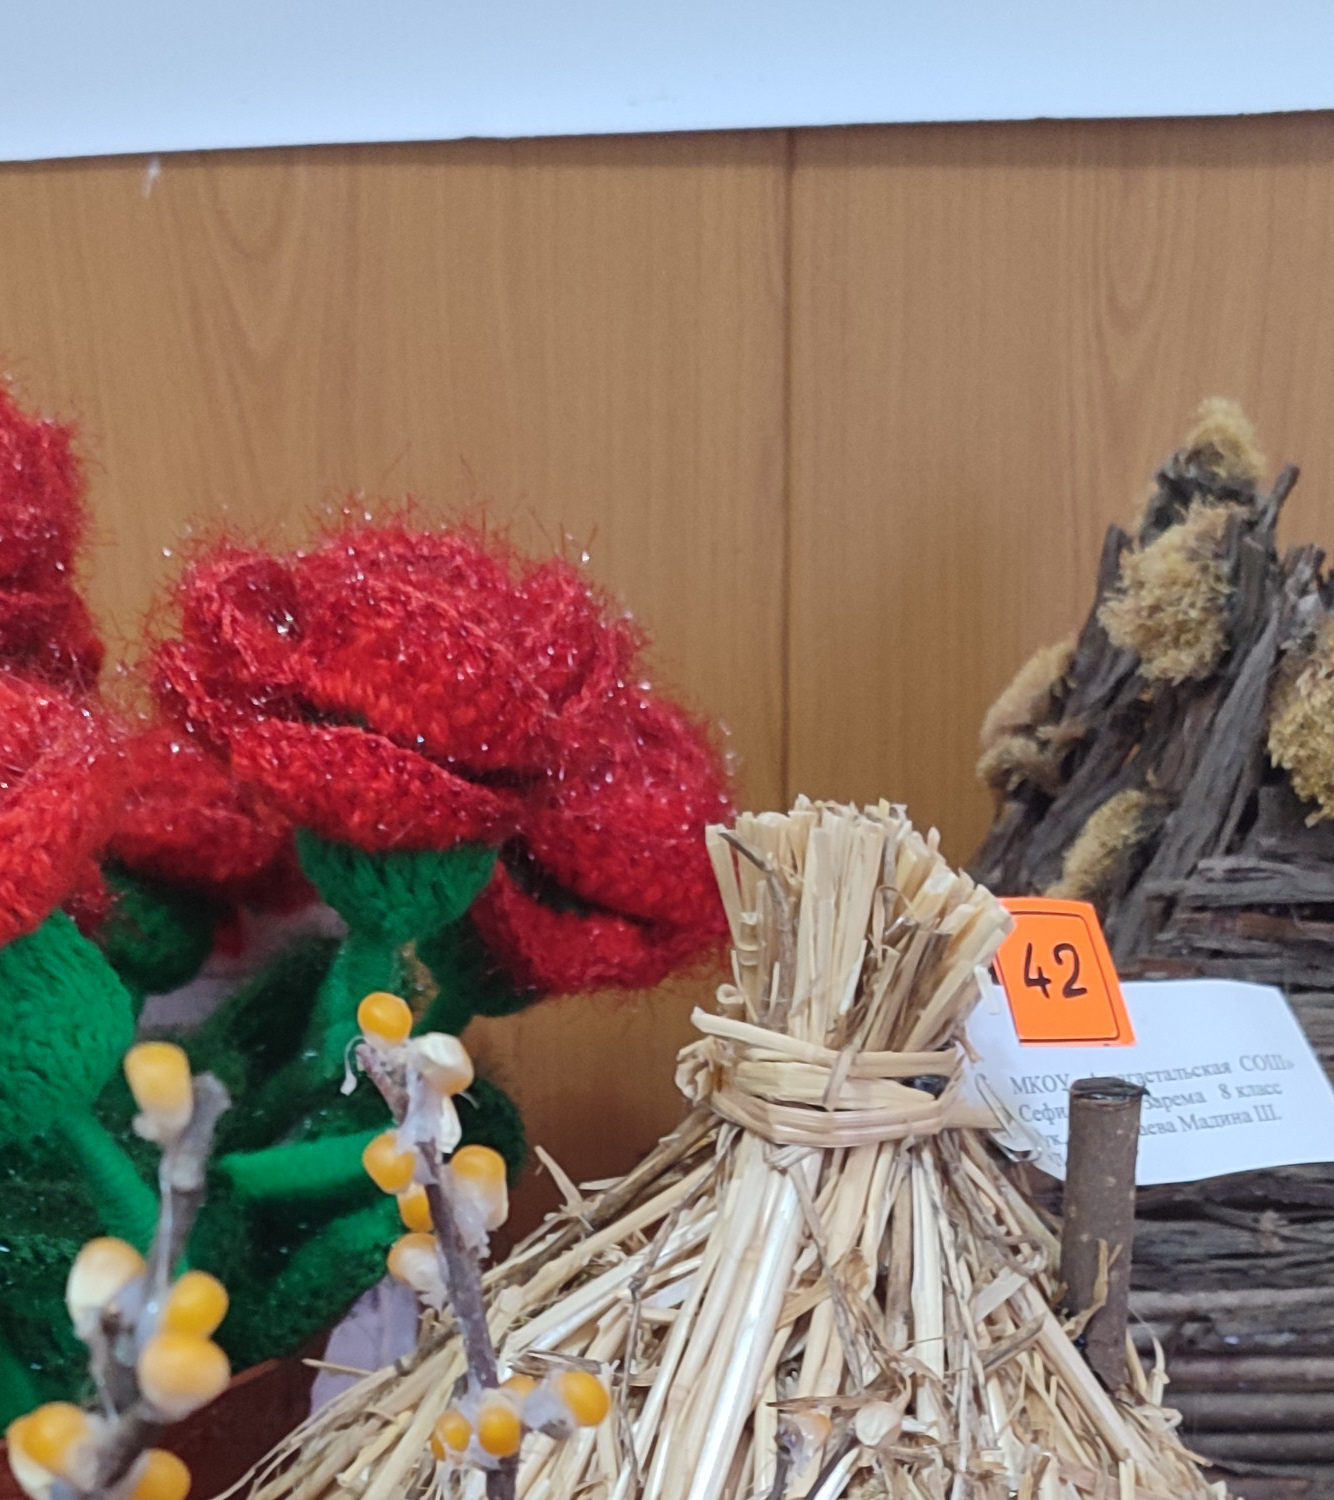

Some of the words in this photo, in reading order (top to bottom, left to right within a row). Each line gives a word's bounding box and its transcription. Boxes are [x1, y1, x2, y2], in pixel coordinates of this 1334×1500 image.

[1023, 942, 1088, 1000] 42
[1009, 1073, 1070, 1096] МКОУ
[1218, 1083, 1232, 1101] 8
[1235, 1083, 1283, 1099] класс
[1177, 1110, 1254, 1133] Мадина
